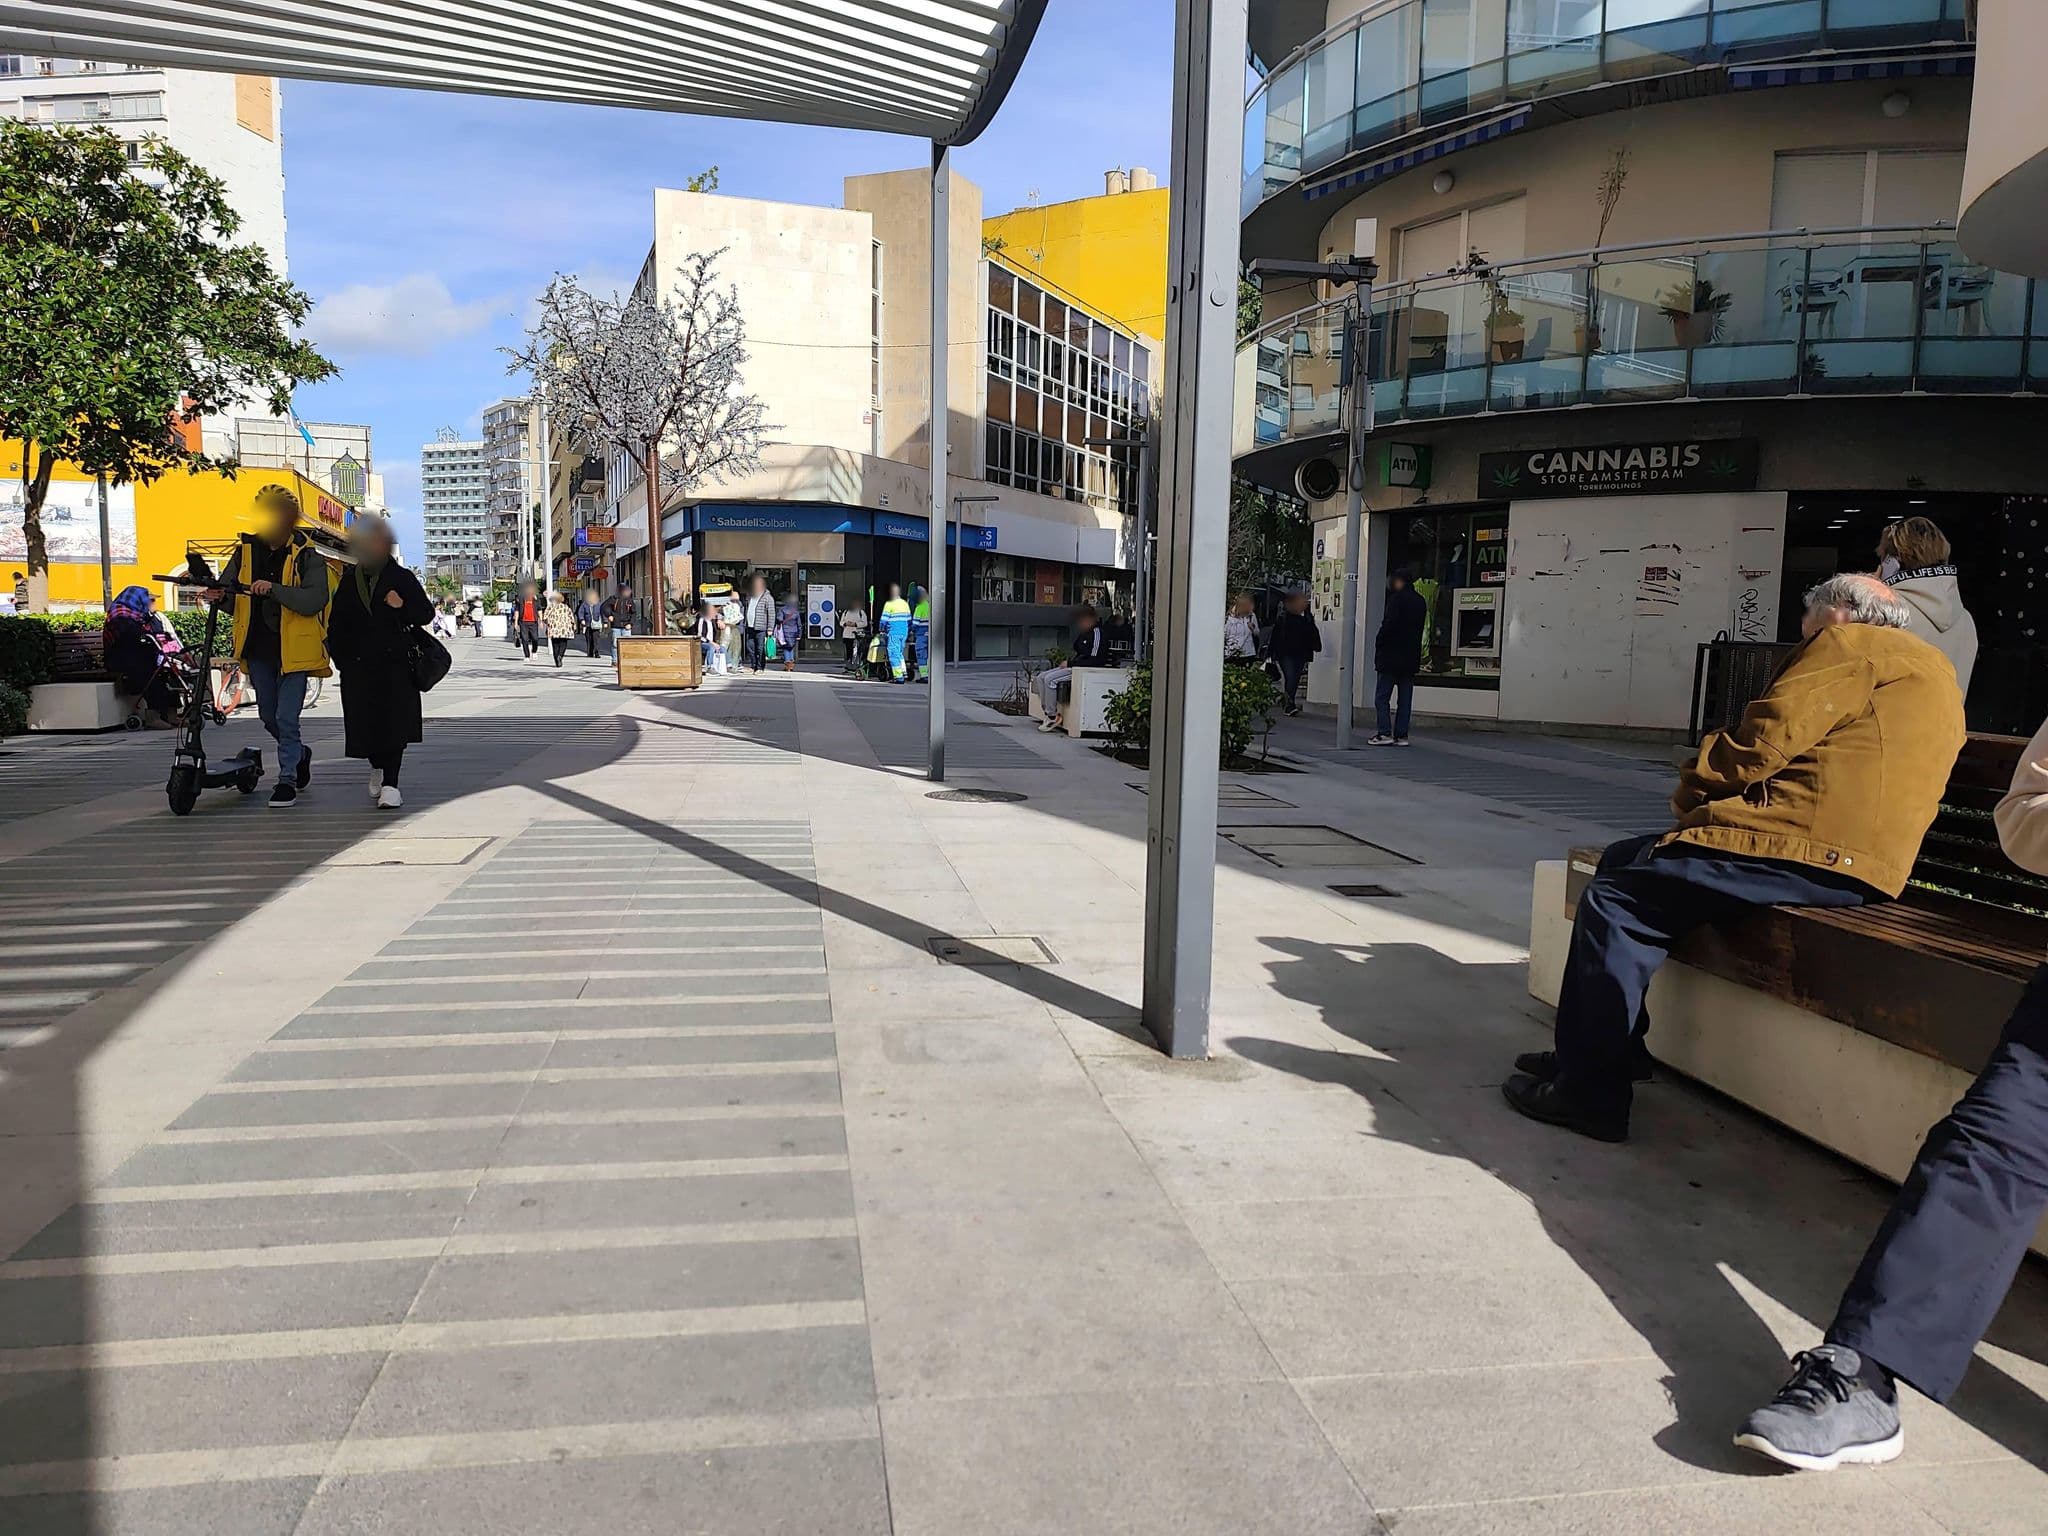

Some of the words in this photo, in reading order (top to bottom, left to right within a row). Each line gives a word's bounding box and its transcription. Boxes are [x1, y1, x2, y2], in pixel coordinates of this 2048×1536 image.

[1392, 457, 1417, 472] ATM
[1527, 444, 1701, 475] CANNABIS
[1540, 473, 1585, 486] STORE
[1590, 468, 1684, 483] AMSTERDAM
[716, 516, 798, 529] SabadellSolbank
[1912, 567, 1934, 577] LIFE
[1933, 566, 1944, 575] IS
